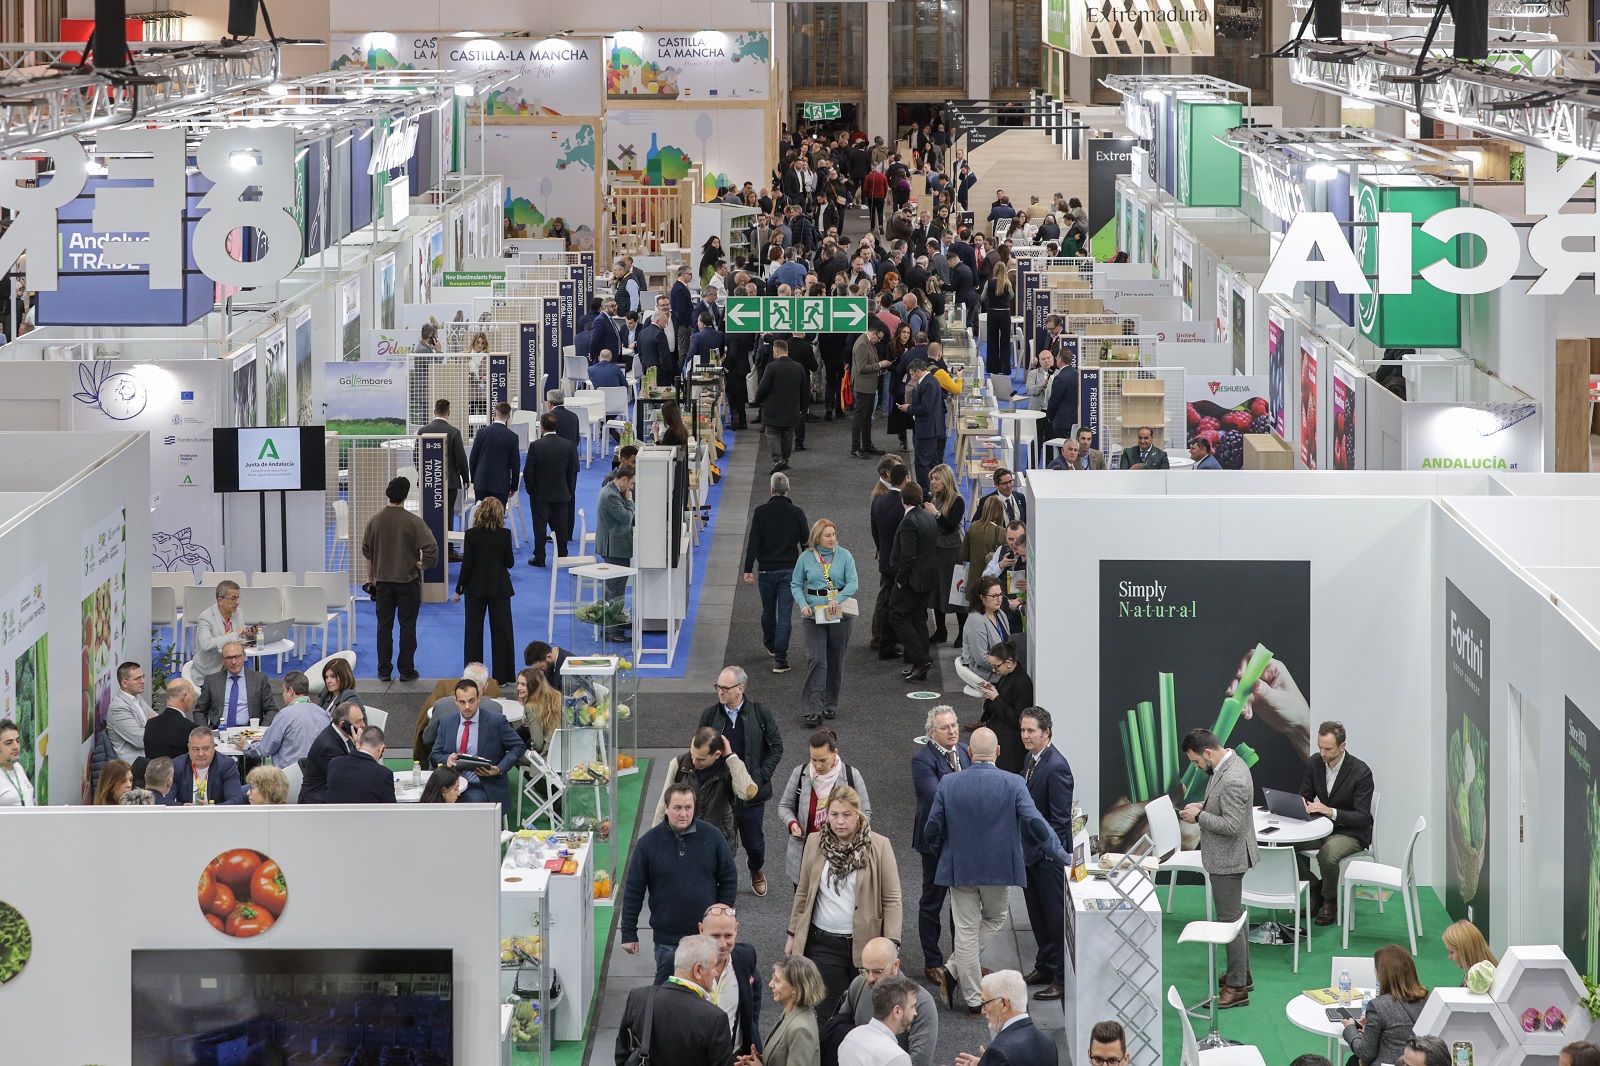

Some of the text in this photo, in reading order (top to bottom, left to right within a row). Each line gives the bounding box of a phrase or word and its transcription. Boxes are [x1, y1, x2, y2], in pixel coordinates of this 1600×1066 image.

[1088, 6, 1208, 23] Extremadura
[413, 50, 427, 60] LA
[450, 49, 589, 61] CASTILLA-LA MANCHA
[657, 48, 725, 58] LA MANCHA
[498, 373, 506, 387] LOS
[1212, 384, 1250, 393] FRESHUELVA
[1421, 455, 1518, 470] ANDALUCÍA at
[424, 458, 433, 489] TRADE
[434, 458, 444, 509] ANDALUCÍA
[1118, 579, 1167, 602] Simply
[1450, 609, 1483, 679] Fortini
